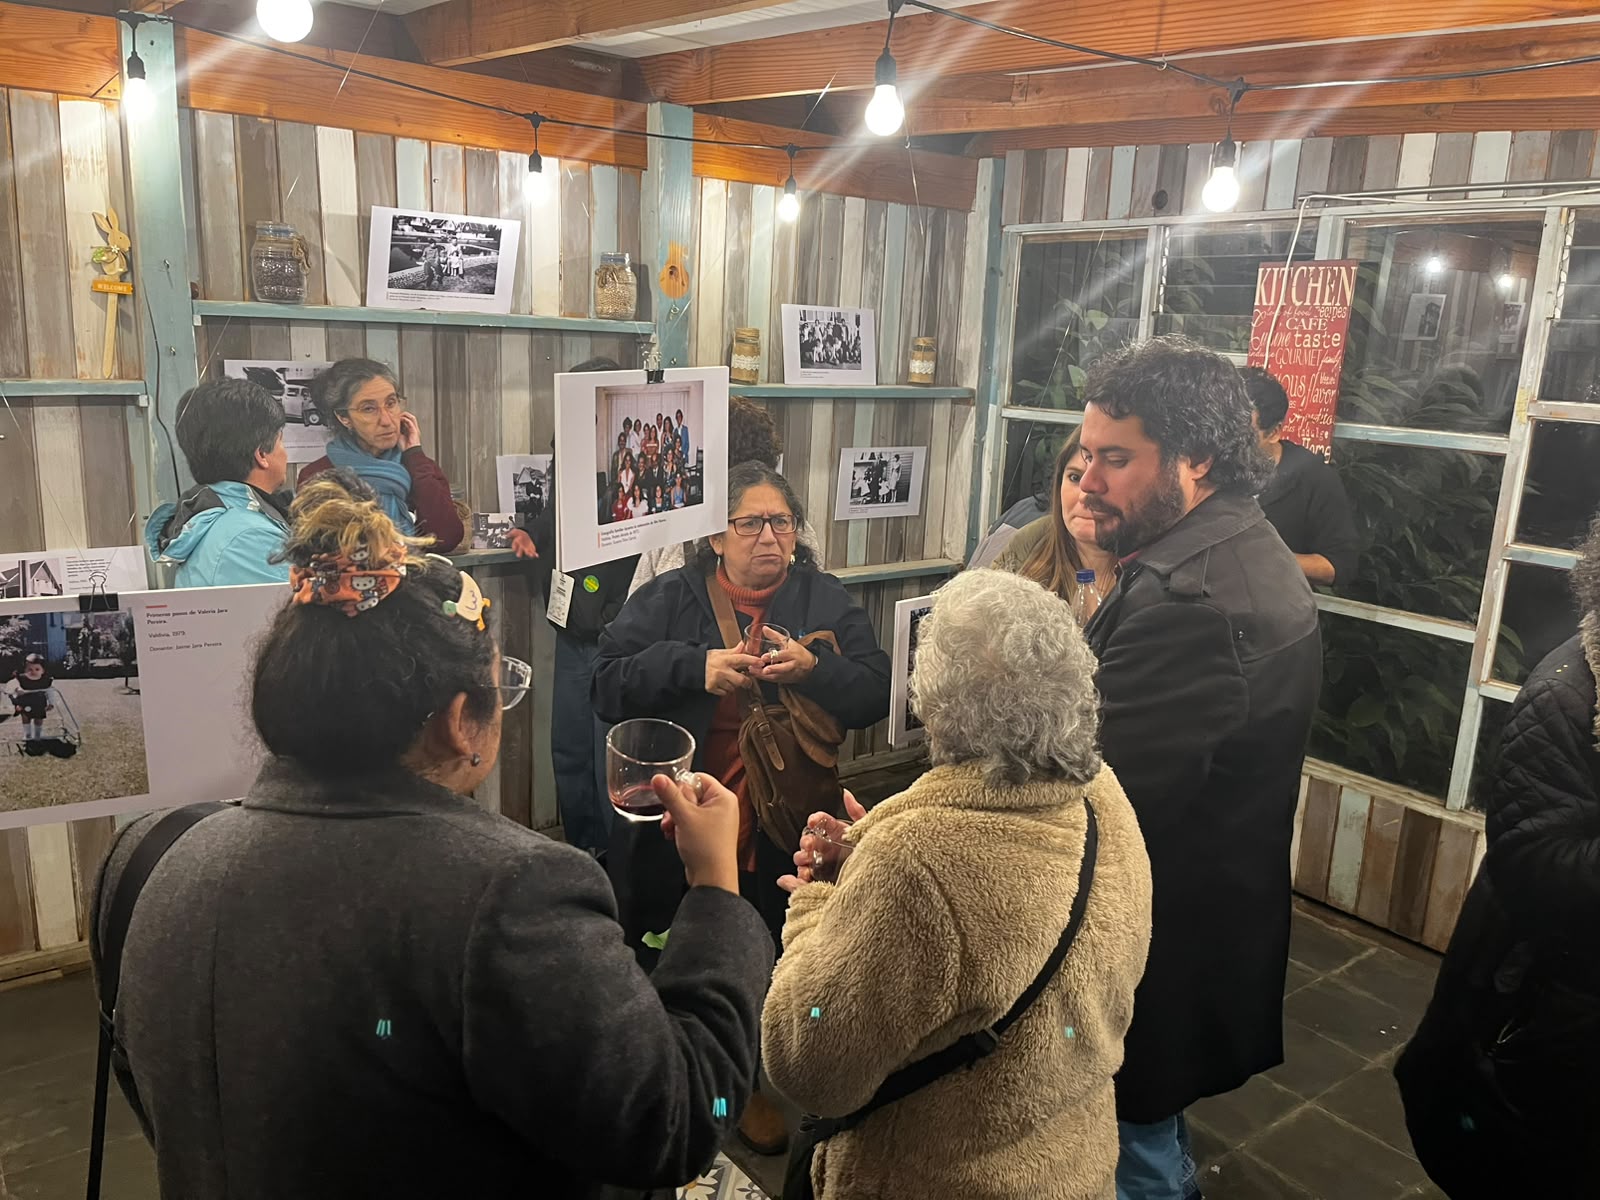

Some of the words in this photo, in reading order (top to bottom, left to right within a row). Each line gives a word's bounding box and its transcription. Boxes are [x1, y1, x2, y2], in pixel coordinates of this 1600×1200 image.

[97, 283, 127, 292] WELCOME
[1254, 266, 1358, 307] KITCHEN
[1294, 330, 1341, 349] taste
[1275, 347, 1322, 367] GOURMET
